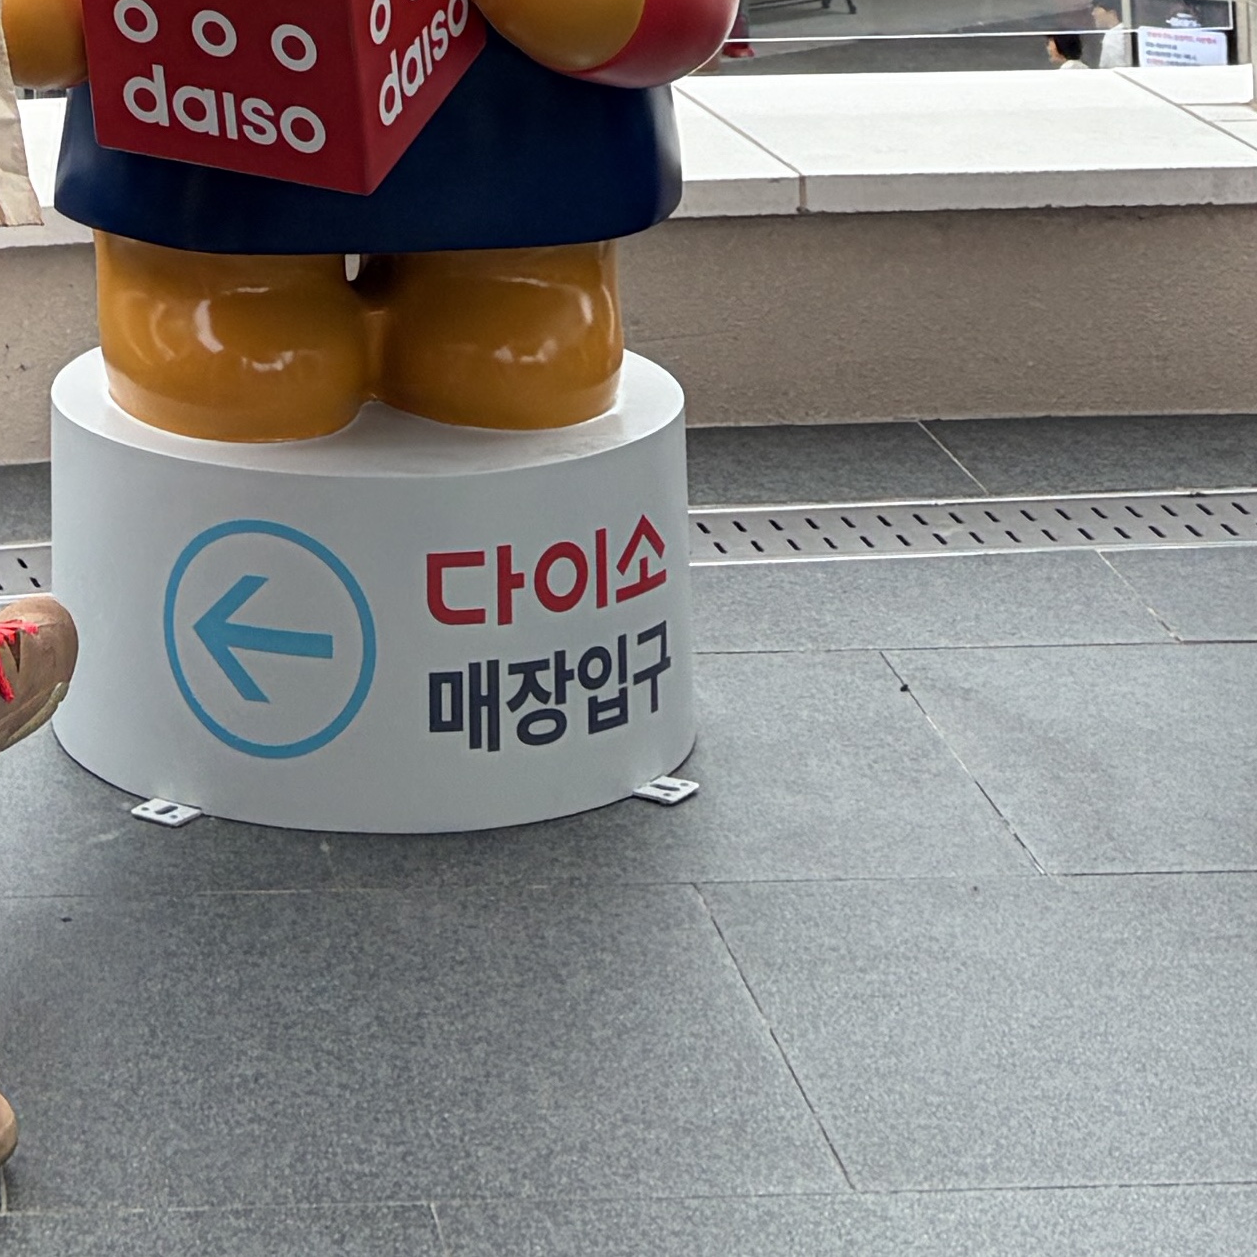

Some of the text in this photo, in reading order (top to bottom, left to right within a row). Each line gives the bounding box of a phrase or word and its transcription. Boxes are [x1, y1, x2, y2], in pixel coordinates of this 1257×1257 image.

[123, 63, 327, 154] daiso
[426, 513, 668, 626] 다이소
[428, 619, 672, 753] 매장입구
